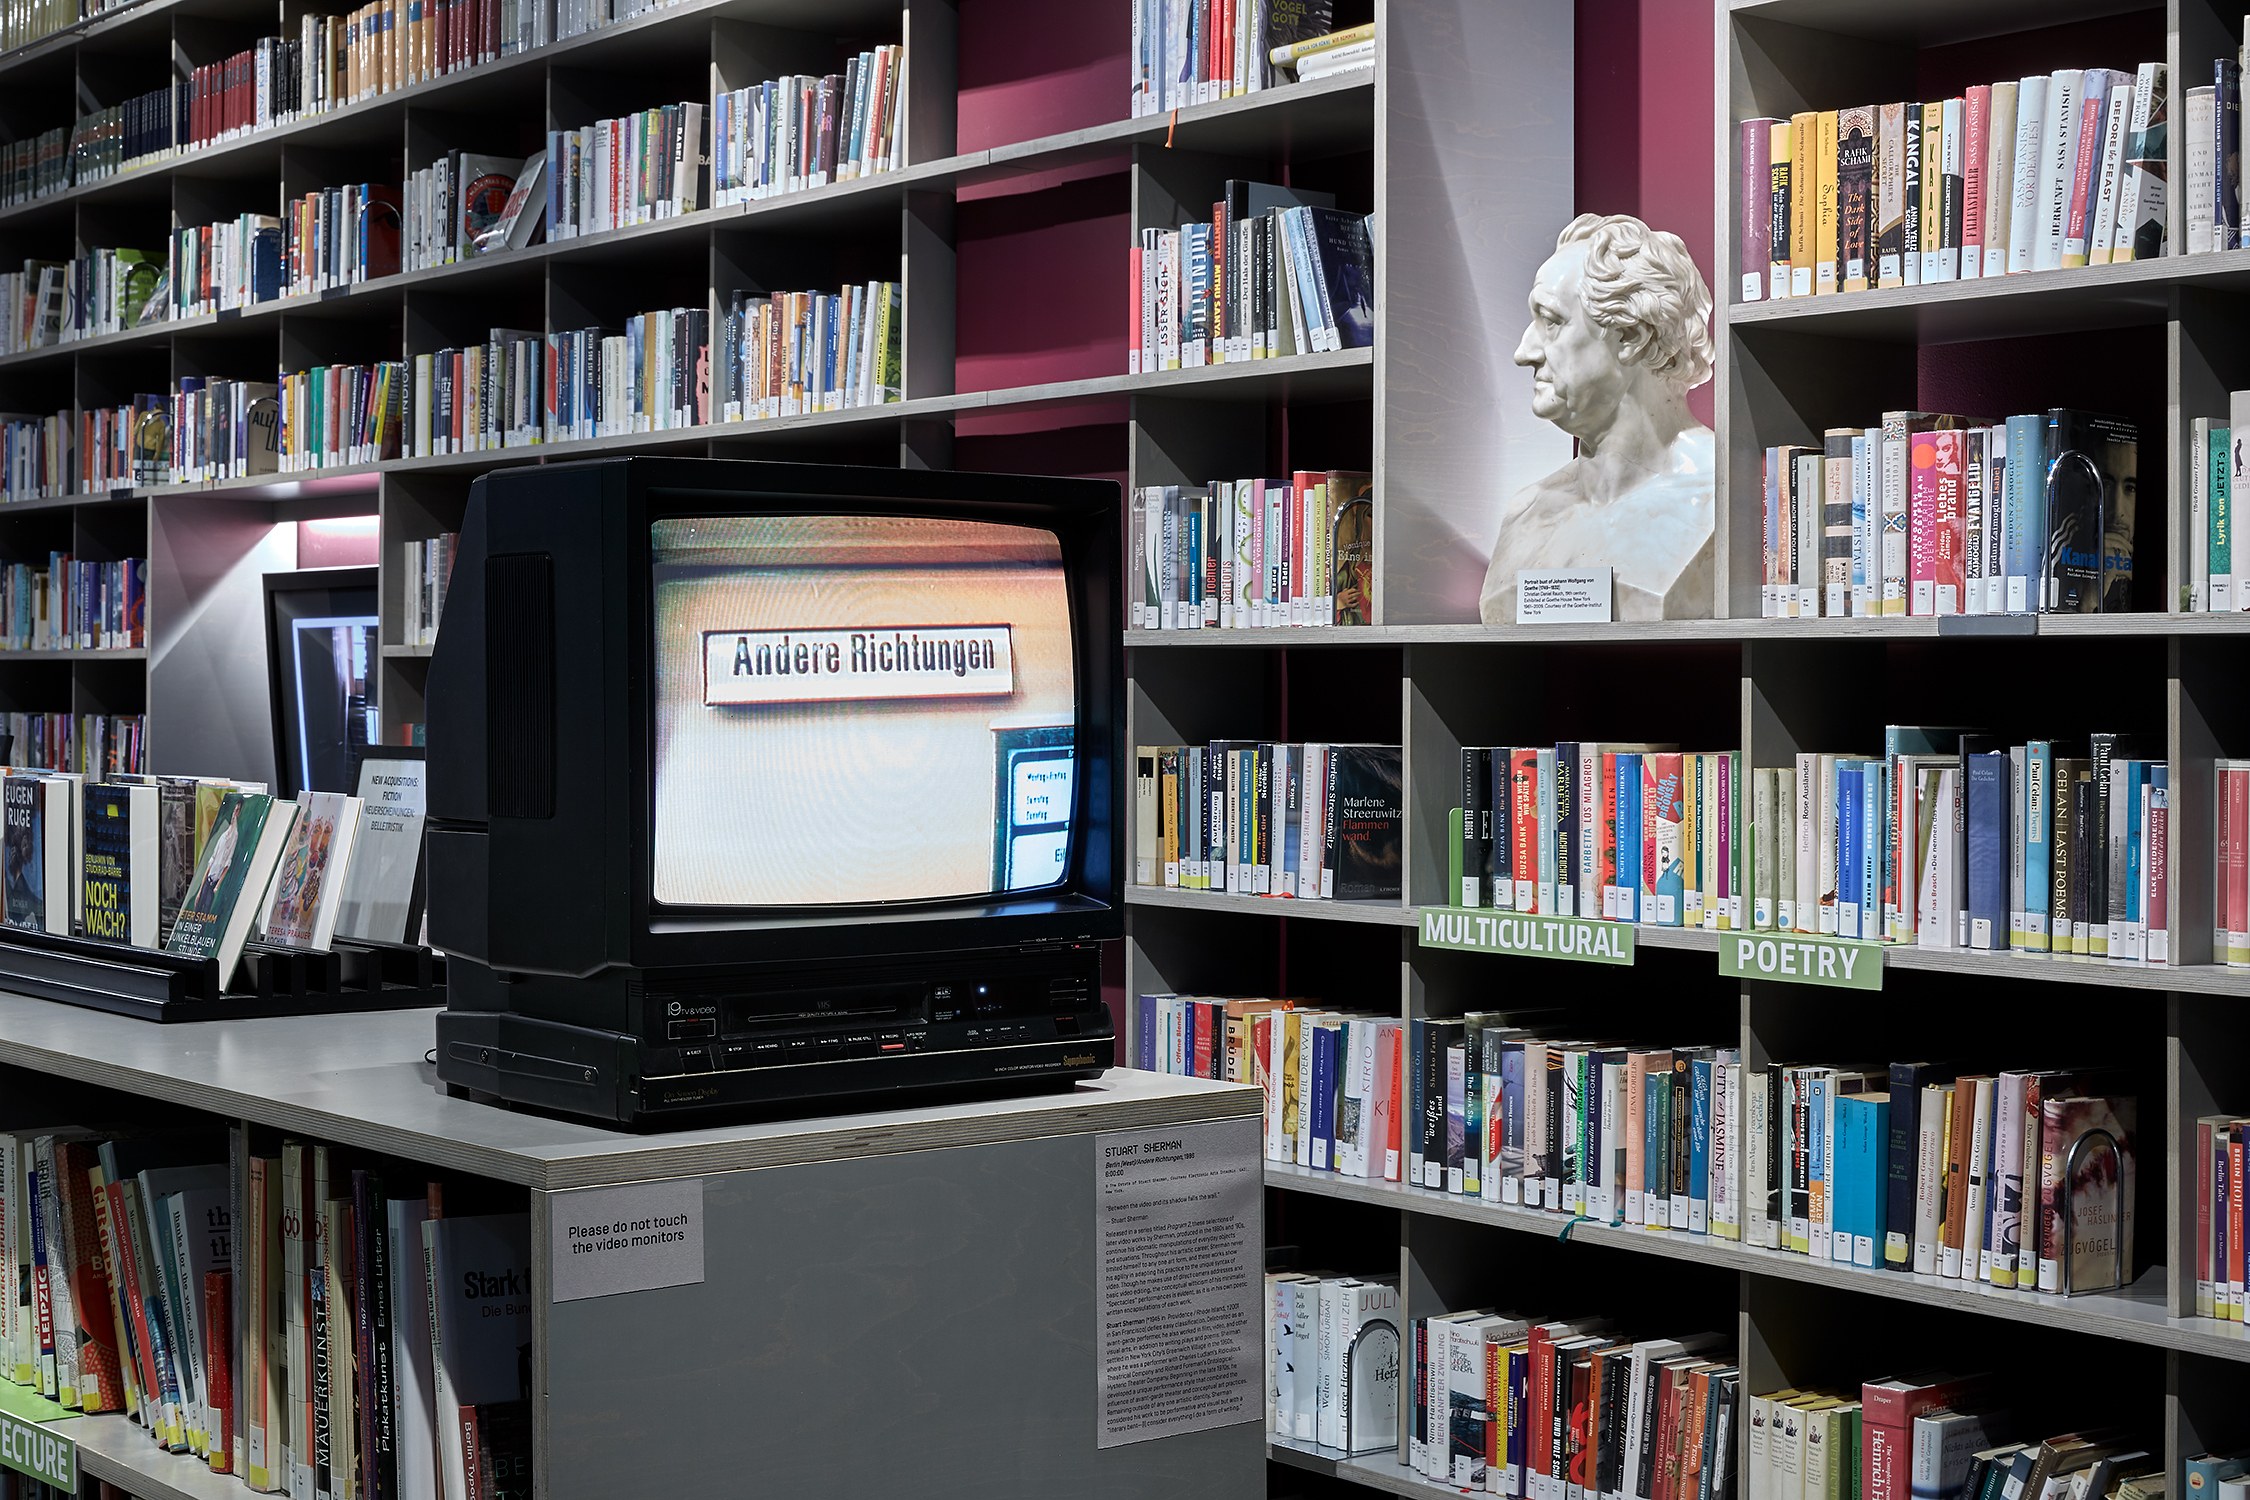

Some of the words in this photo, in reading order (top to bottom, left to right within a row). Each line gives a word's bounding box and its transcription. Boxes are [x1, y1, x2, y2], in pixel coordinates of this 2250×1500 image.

[1272, 12, 1299, 26] GOTT
[1273, 0, 1307, 15] VOGEL
[2028, 119, 2039, 150] FEST
[2109, 100, 2122, 148] BEFORE
[1840, 155, 1871, 166] SCHAMI
[1844, 147, 1868, 158] RAFIK
[1905, 120, 1920, 190] KANGAL
[2026, 151, 2035, 181] DEM
[1779, 167, 1788, 187] RAFIK
[2102, 163, 2114, 202] FEAST
[1819, 184, 1835, 226] Sophia
[1848, 193, 1862, 202] The
[2024, 185, 2034, 208] VOR
[2051, 177, 2064, 237] HERKUNFT
[1844, 206, 1865, 215] Dark
[1845, 216, 1864, 226] Side
[1910, 205, 1918, 228] ANNA
[1845, 241, 1865, 249] Love
[1849, 228, 1859, 239] of
[1909, 230, 1918, 251] YELIZ
[1191, 232, 1206, 324] IDENTITTI
[772, 343, 777, 357] Am
[2218, 451, 2226, 459] 3
[2217, 460, 2225, 497] JETZT
[1937, 477, 1947, 523] Liebes
[1947, 479, 1957, 520] brand
[1968, 462, 1981, 530] EVANGELIO
[2216, 518, 2226, 545] Lyrik
[1337, 551, 1361, 562] Eins
[1853, 526, 1862, 570] EISTAU
[1221, 561, 1232, 602] Sartoris
[733, 635, 840, 676] Andere
[851, 633, 995, 677] Richtungen
[2100, 743, 2112, 771] Paul
[371, 775, 384, 785] NEW
[1328, 752, 1338, 791] Marlene
[1584, 758, 1592, 804] MILAGROS
[2032, 762, 2041, 782] Paul
[5, 785, 33, 806] EUGEN
[382, 792, 402, 801] FICTION
[1557, 760, 1565, 823] BARBETTA
[1656, 777, 1668, 807] ALINA
[1659, 772, 1679, 819] BRONSKY
[2031, 783, 2040, 810] Celan:
[2056, 768, 2068, 819] CELAN
[2099, 773, 2111, 798] Celan
[1343, 797, 1385, 808] Marlene
[1343, 808, 1403, 819] Streeruwitz
[1648, 787, 1656, 839] SUPERHELD
[8, 807, 31, 828] RUGE
[370, 821, 404, 832] BELLETRISTIK
[1327, 792, 1336, 849] Streeruwitz
[1343, 820, 1389, 829] Flammen
[1464, 810, 1474, 840] ELLBOGEN
[1584, 810, 1592, 823] LOS
[2031, 812, 2040, 839] Poems
[1342, 830, 1371, 841] wand.
[2056, 831, 2068, 867] LAST
[85, 854, 106, 865] BENJAMIN
[106, 856, 116, 866] VON
[1584, 828, 1592, 874] BARBETTA
[85, 863, 122, 878] STUCKRAD-BARRE
[85, 880, 118, 909] NOCH
[2055, 874, 2067, 919] POEMS
[85, 908, 125, 939] WACH?
[177, 921, 183, 931] IN
[183, 922, 202, 934] EINER
[197, 912, 218, 925] STAMM
[268, 926, 286, 936] TERESA
[1424, 913, 1626, 959] MULTICULTURAL
[1737, 938, 1859, 980] POETRY
[1302, 1021, 1310, 1058] WELT
[1063, 1053, 1096, 1066] Symphonic
[1361, 1046, 1373, 1092] KIRIO
[1466, 1091, 1474, 1108] Dark
[1429, 1100, 1437, 1137] weißes
[1105, 1145, 1138, 1157] STUART
[1143, 1140, 1182, 1153] SHERMAN
[1920, 1130, 1928, 1173] Gernhardt
[36, 1159, 49, 1201] BERLIN
[2077, 1205, 2103, 1216] JOSEF
[569, 1225, 609, 1239] Please
[613, 1221, 627, 1233] do
[630, 1219, 651, 1231] not
[653, 1213, 688, 1228] touch
[376, 1229, 384, 1276] Litter
[572, 1242, 593, 1254] the
[596, 1238, 628, 1251] video
[631, 1231, 685, 1246] monitors
[464, 1271, 520, 1298] Stark
[38, 1269, 52, 1345] LEIPZIG
[377, 1285, 385, 1328] Ernst
[482, 1305, 502, 1317] Die
[1360, 1293, 1397, 1312] JULI
[1340, 1316, 1349, 1340] JULI
[316, 1307, 329, 1466] MAUERKUNST
[382, 1342, 390, 1451] Plakatkunst
[1322, 1374, 1330, 1409] Welten
[1873, 1395, 1892, 1405] Draper
[464, 1422, 475, 1460] Berlin
[1871, 1429, 1885, 1491] Heinrich
